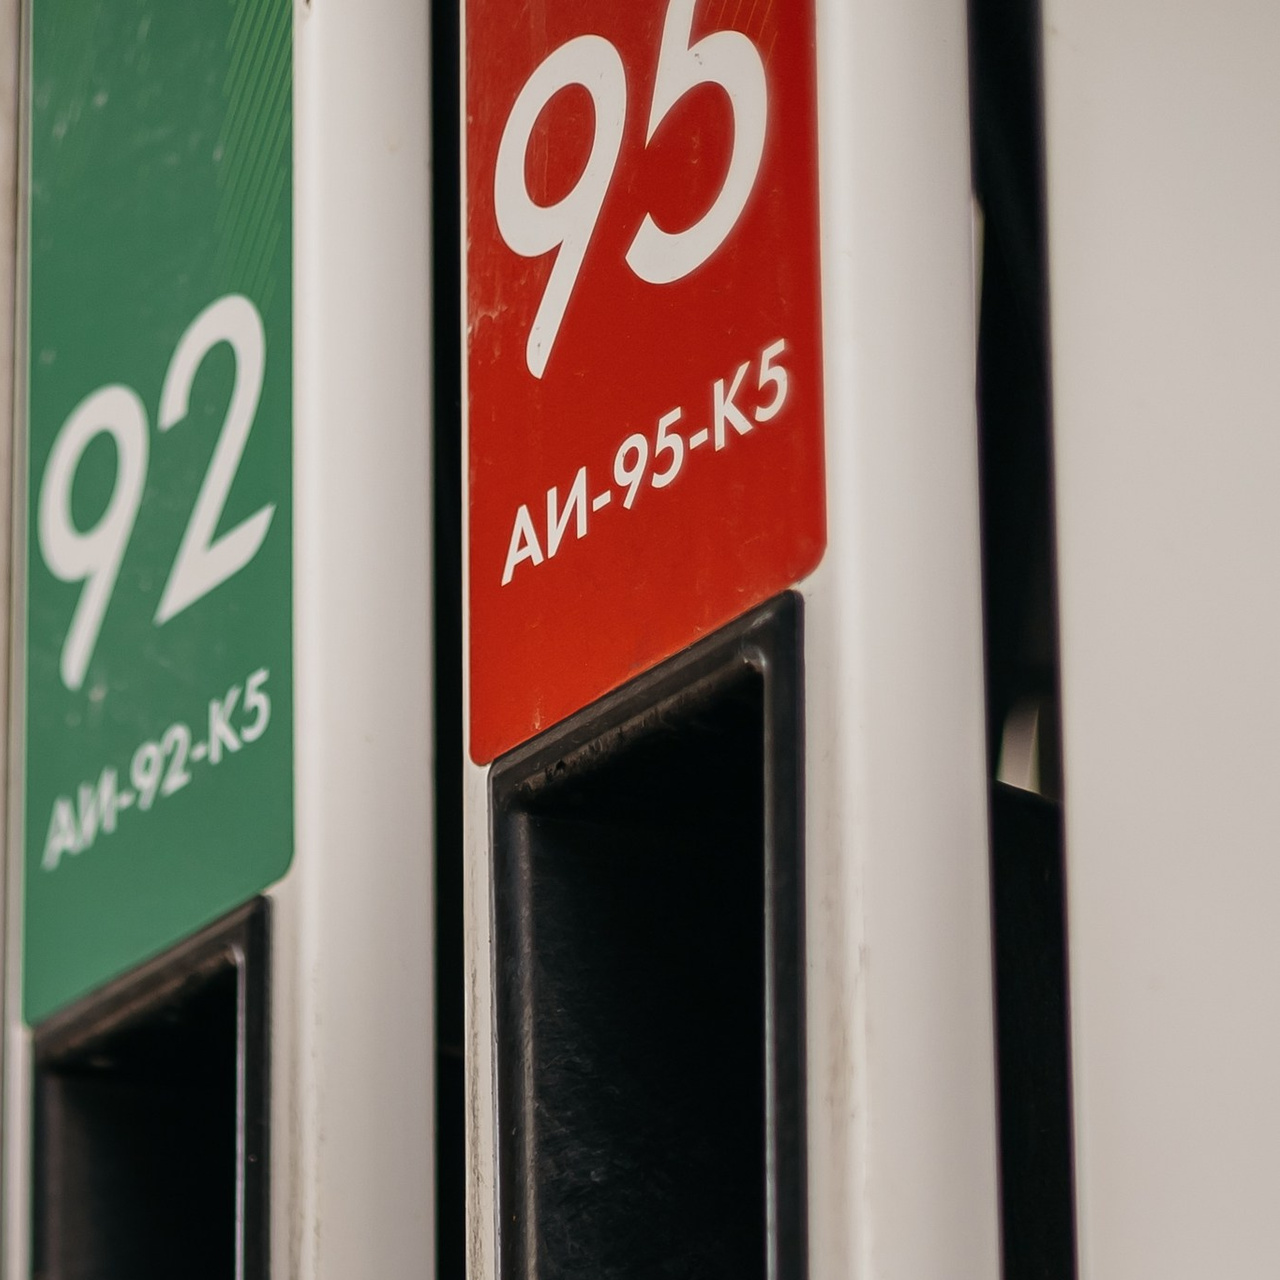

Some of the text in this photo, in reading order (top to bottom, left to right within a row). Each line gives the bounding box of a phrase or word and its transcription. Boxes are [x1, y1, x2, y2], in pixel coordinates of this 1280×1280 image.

[494, 0, 767, 379] 95
[38, 294, 276, 691] 92
[501, 339, 789, 586] АИ-95-К5
[40, 668, 272, 872] АИ-92-К5
